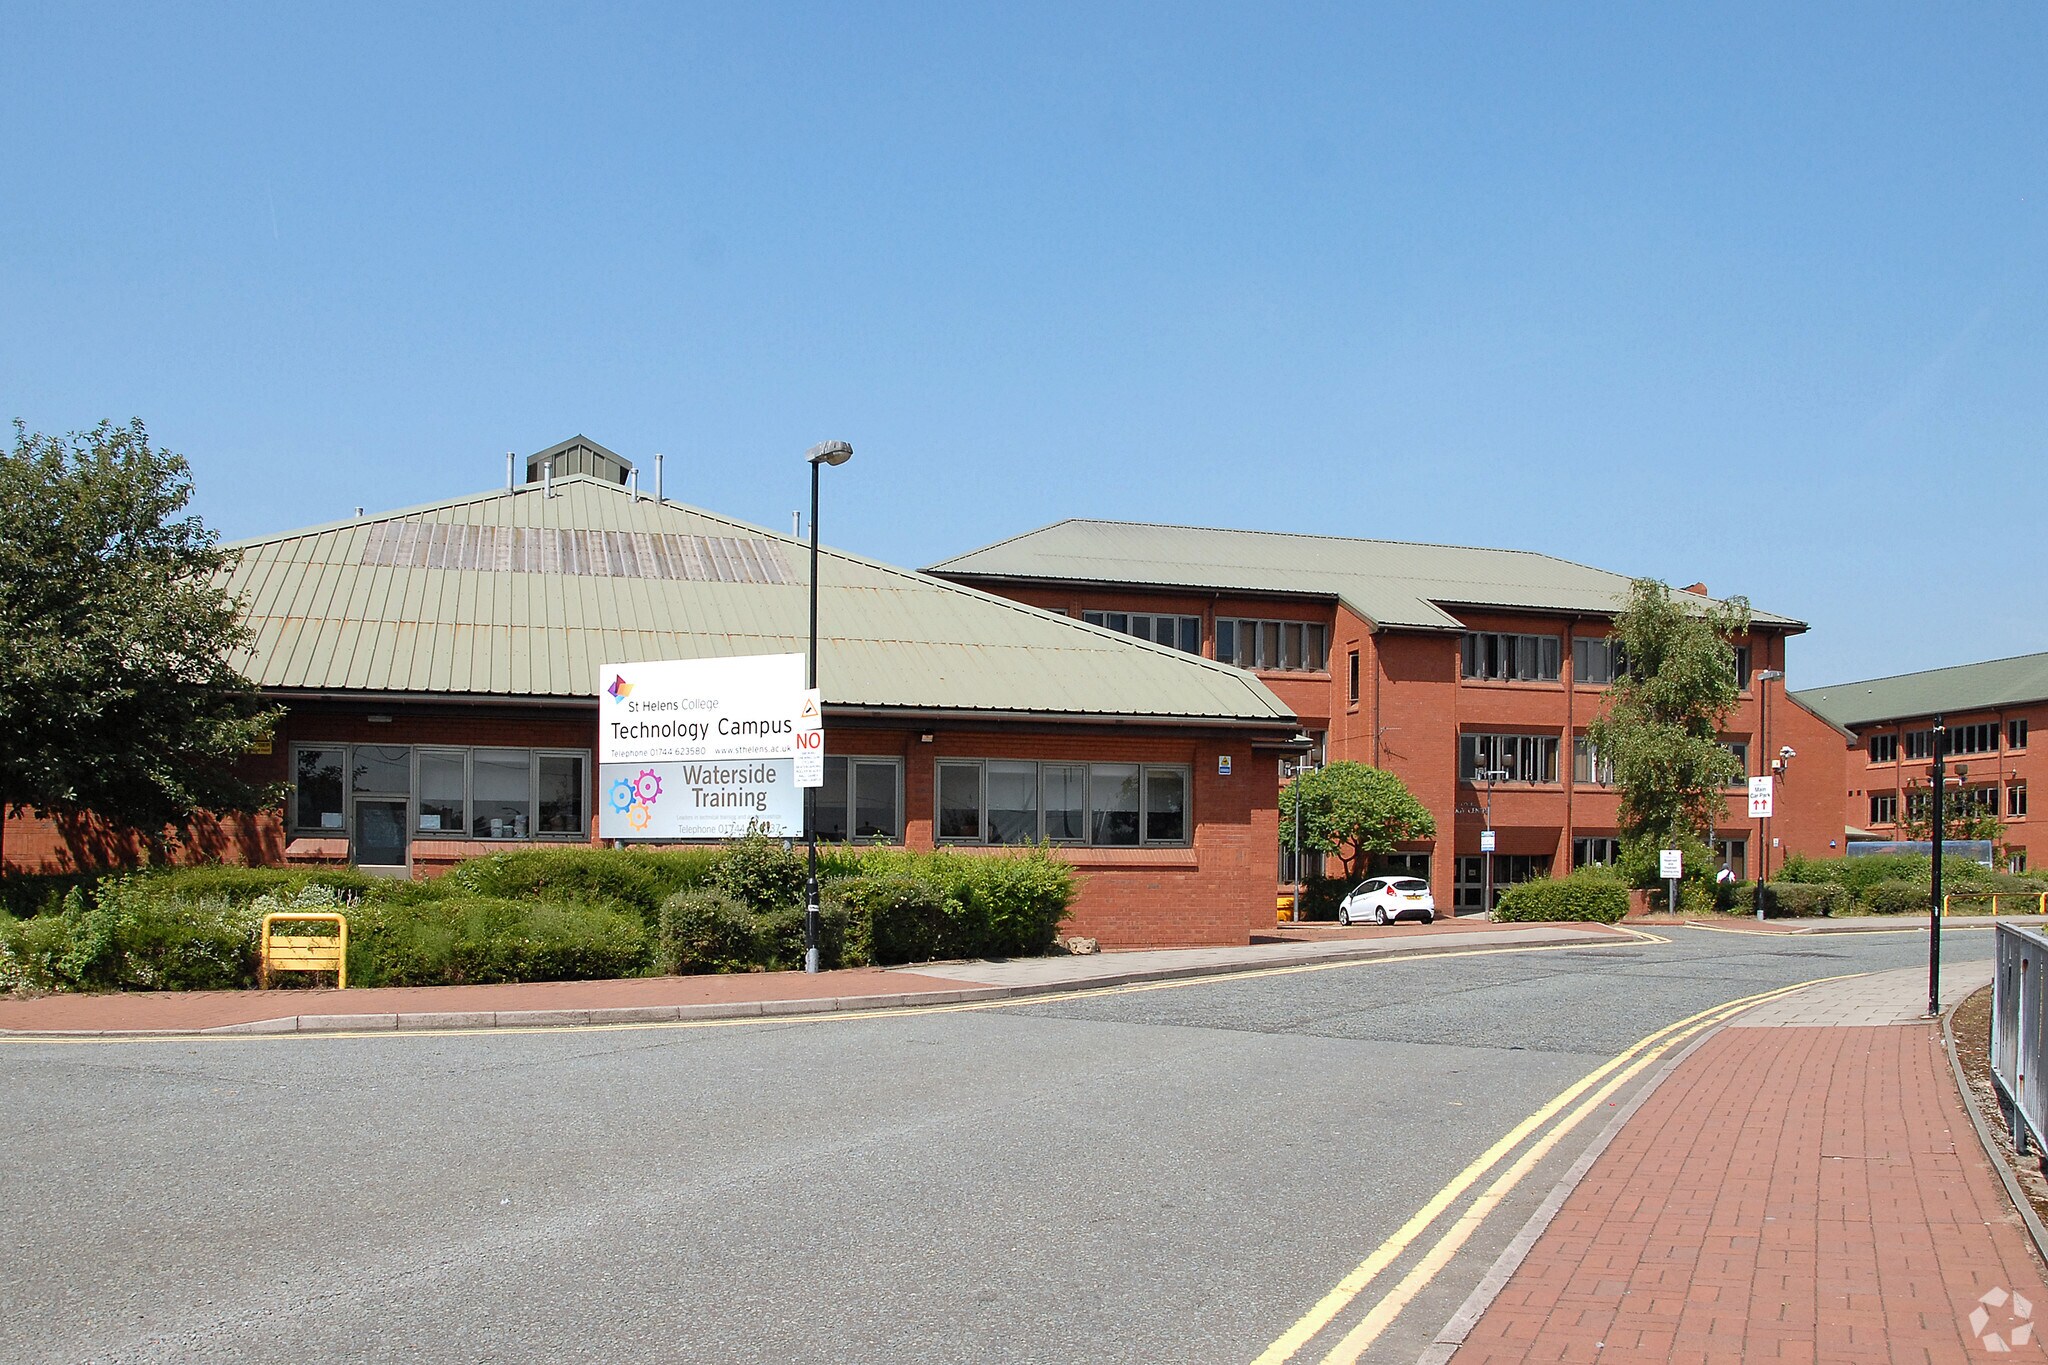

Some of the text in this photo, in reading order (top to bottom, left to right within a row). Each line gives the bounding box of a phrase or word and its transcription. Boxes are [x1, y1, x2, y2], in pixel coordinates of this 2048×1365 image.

[628, 698, 719, 713] St Helens College
[611, 717, 792, 741] Technology Campus
[797, 732, 821, 749] NO
[611, 749, 648, 758] Telephone
[650, 748, 673, 757] 01744
[674, 746, 706, 756] 623580
[715, 745, 792, 754] www.sthelens.ac.uk
[683, 763, 777, 785] Waterside
[691, 787, 767, 812] Training
[678, 824, 716, 835] Telephone
